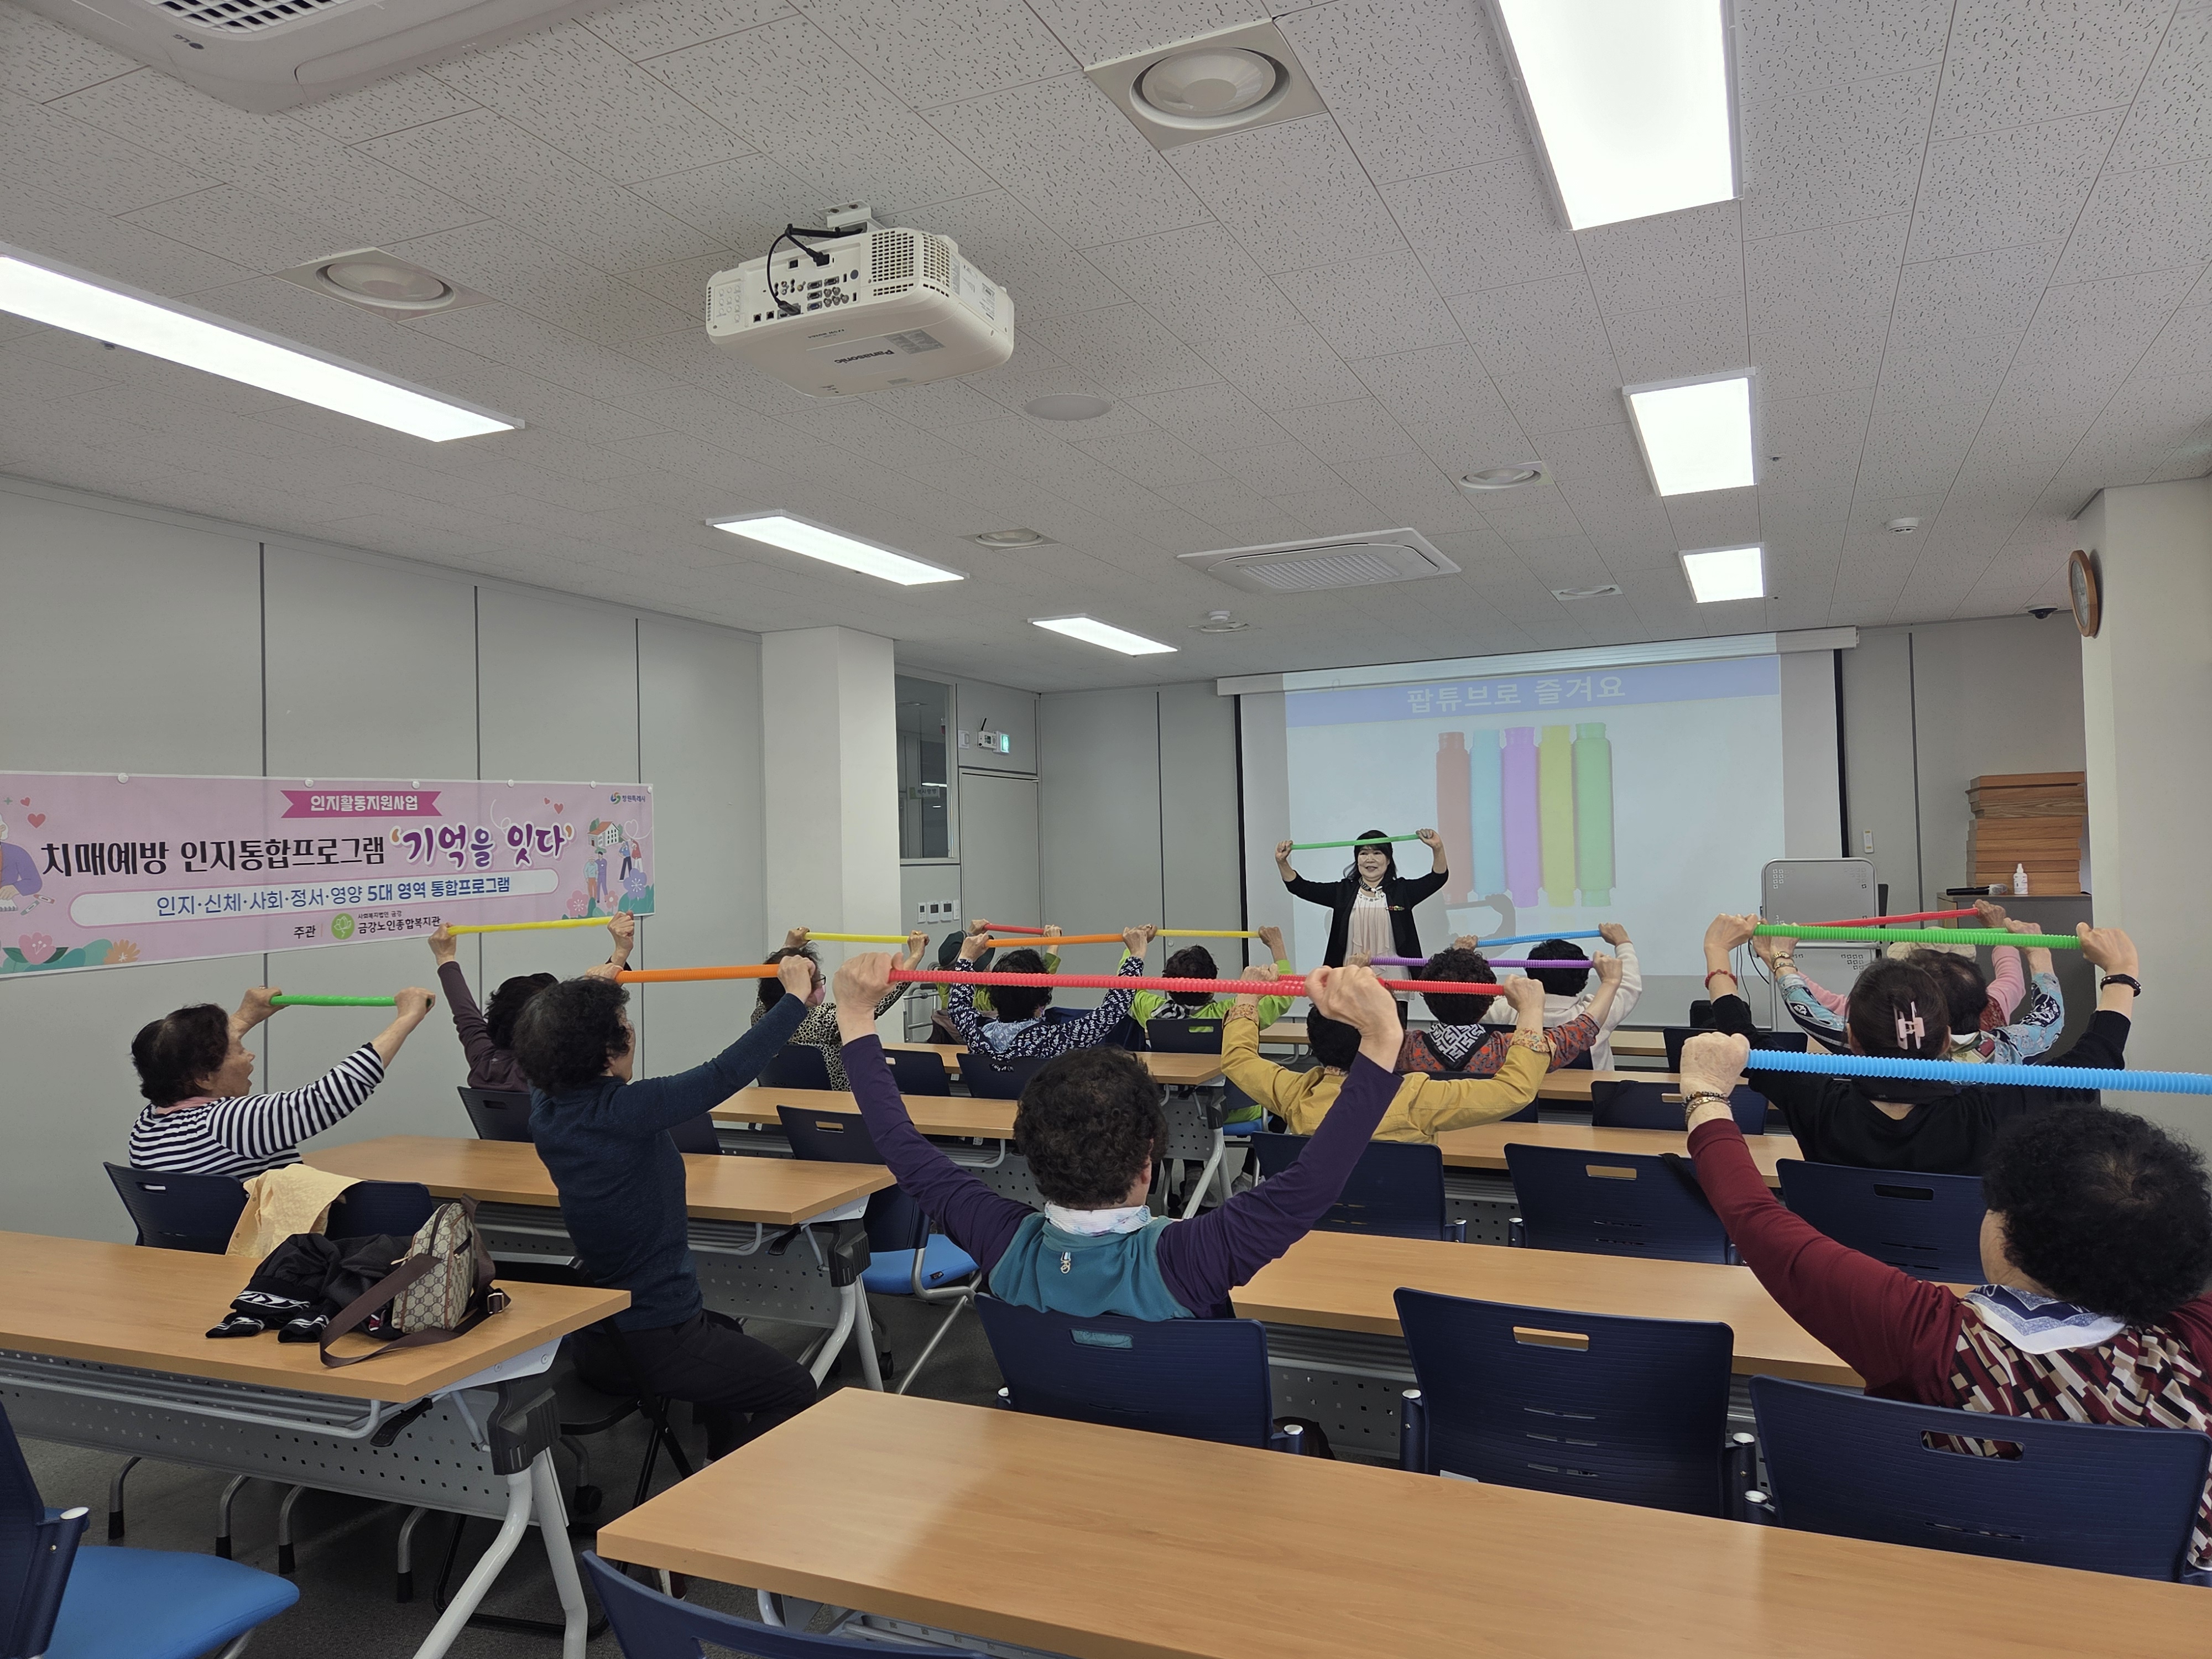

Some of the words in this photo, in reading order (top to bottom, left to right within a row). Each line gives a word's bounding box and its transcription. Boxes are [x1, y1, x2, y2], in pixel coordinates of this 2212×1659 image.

[834, 349, 895, 363] Panasonic
[1407, 683, 1521, 713] 팝튜브로
[1534, 676, 1625, 705] 즐겨요
[310, 795, 418, 812] 인지활동지원사업
[41, 841, 169, 877] 치매예방
[180, 837, 384, 873] 인지통합프로그램
[367, 883, 393, 902] 5대
[398, 881, 426, 899] 영역
[431, 876, 510, 898] 통합프로그램
[294, 925, 316, 940] 주관
[358, 916, 441, 934] 금강노인종합복지관
